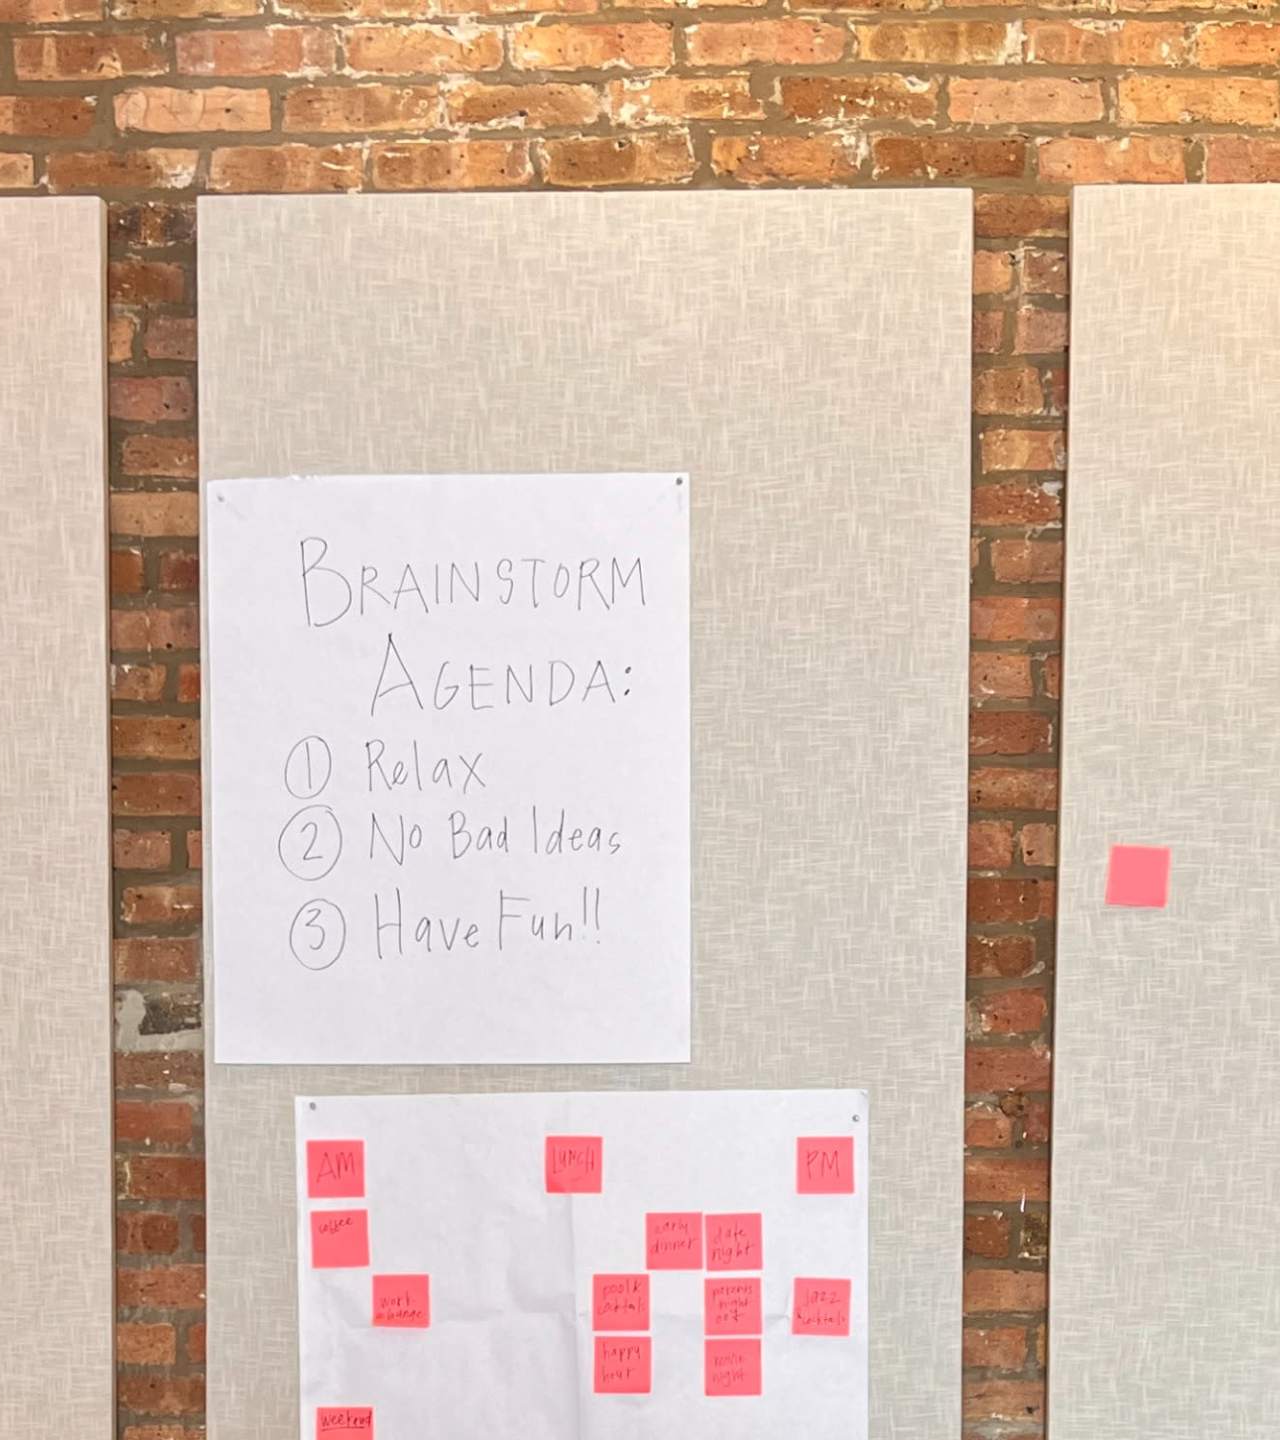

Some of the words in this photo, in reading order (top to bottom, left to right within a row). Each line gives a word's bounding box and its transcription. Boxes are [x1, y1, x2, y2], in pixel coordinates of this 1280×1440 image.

[300, 537, 646, 627] BRAINSTORM
[371, 633, 633, 716] AGENDA:
[365, 739, 487, 794] Relax
[370, 812, 423, 866] No
[449, 810, 509, 860] Bad
[533, 805, 621, 855] Ideas
[374, 888, 480, 960] Have
[316, 1151, 355, 1183] AM
[806, 1149, 840, 1180] PM
